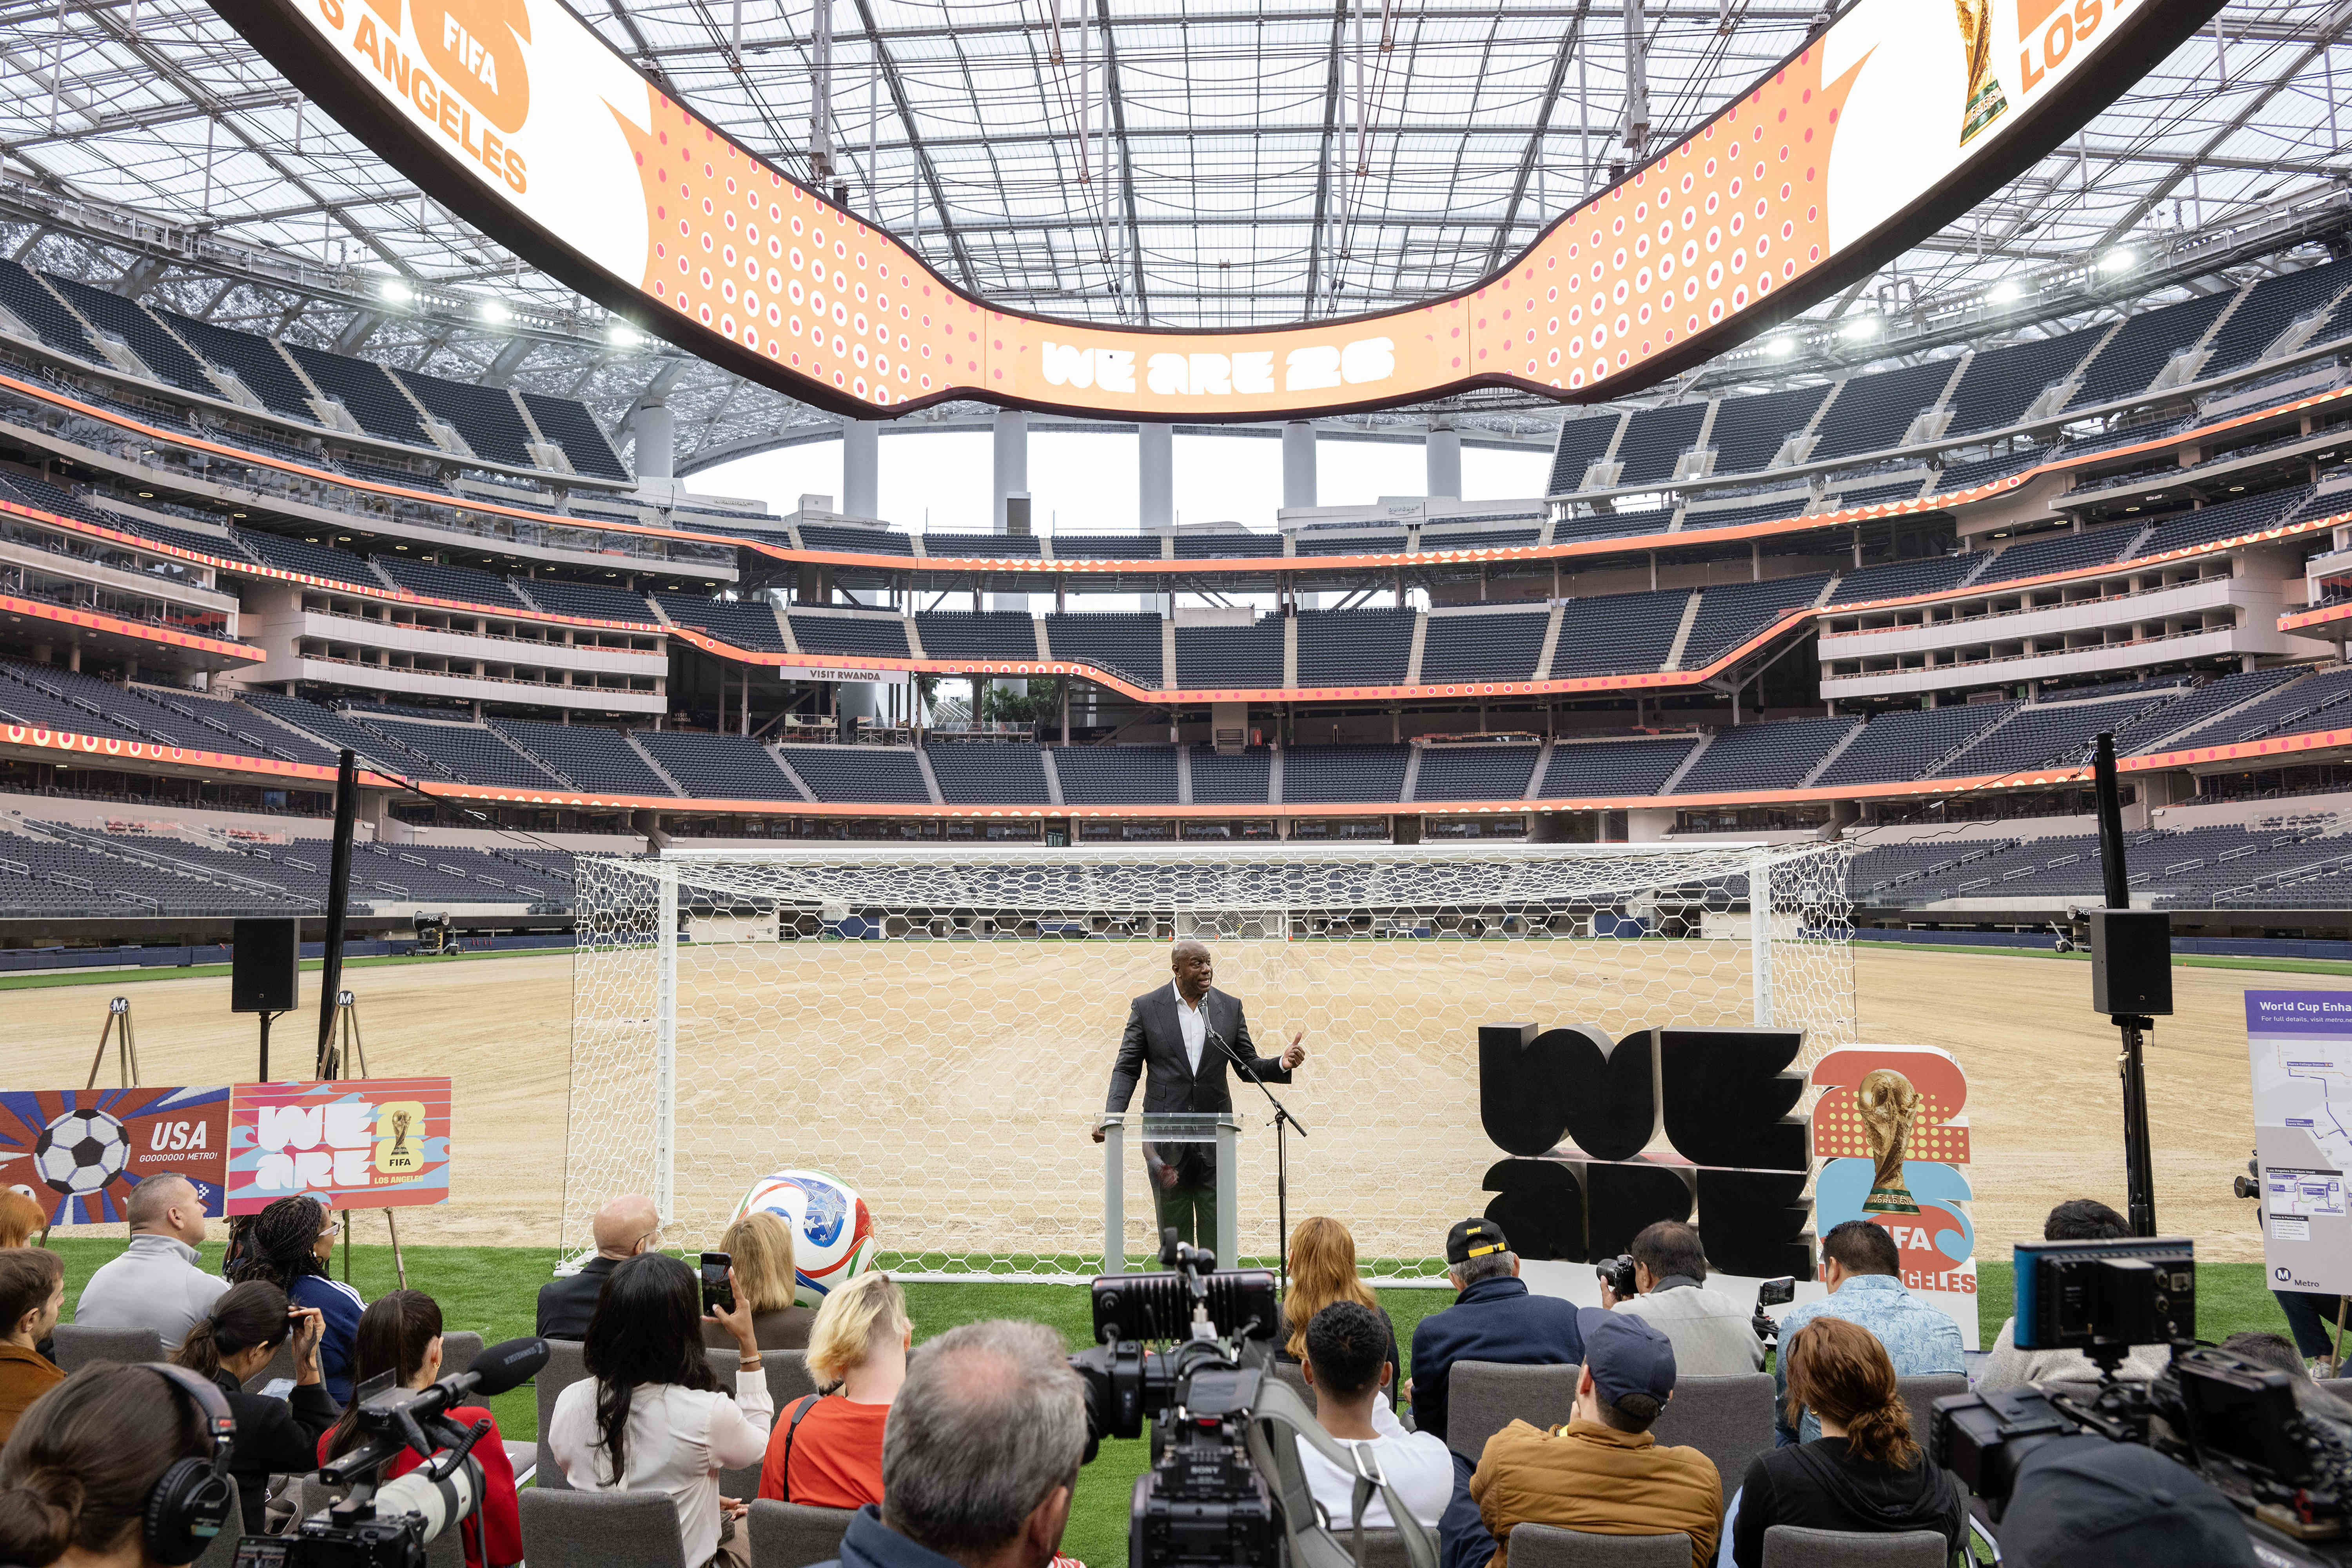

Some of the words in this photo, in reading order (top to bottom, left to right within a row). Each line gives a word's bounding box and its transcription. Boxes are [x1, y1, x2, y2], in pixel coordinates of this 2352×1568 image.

[443, 10, 498, 96] FIFA
[2020, 0, 2103, 94] LOS
[353, 13, 526, 194] ANGELES
[1042, 341, 1136, 393] WE
[1147, 351, 1274, 395] ARE
[1286, 336, 1395, 392] 26
[810, 670, 835, 679] VISIT
[838, 671, 880, 680] RWANDA
[2259, 1002, 2294, 1011] World
[2298, 1002, 2319, 1013] Cup
[2323, 1003, 2352, 1011] Enha
[1478, 1022, 1813, 1171] WE
[151, 1121, 206, 1151] USA
[258, 1102, 372, 1151] WE
[187, 1152, 218, 1161] METRO!
[256, 1150, 371, 1190] ARE
[390, 1175, 424, 1183] ANGELES
